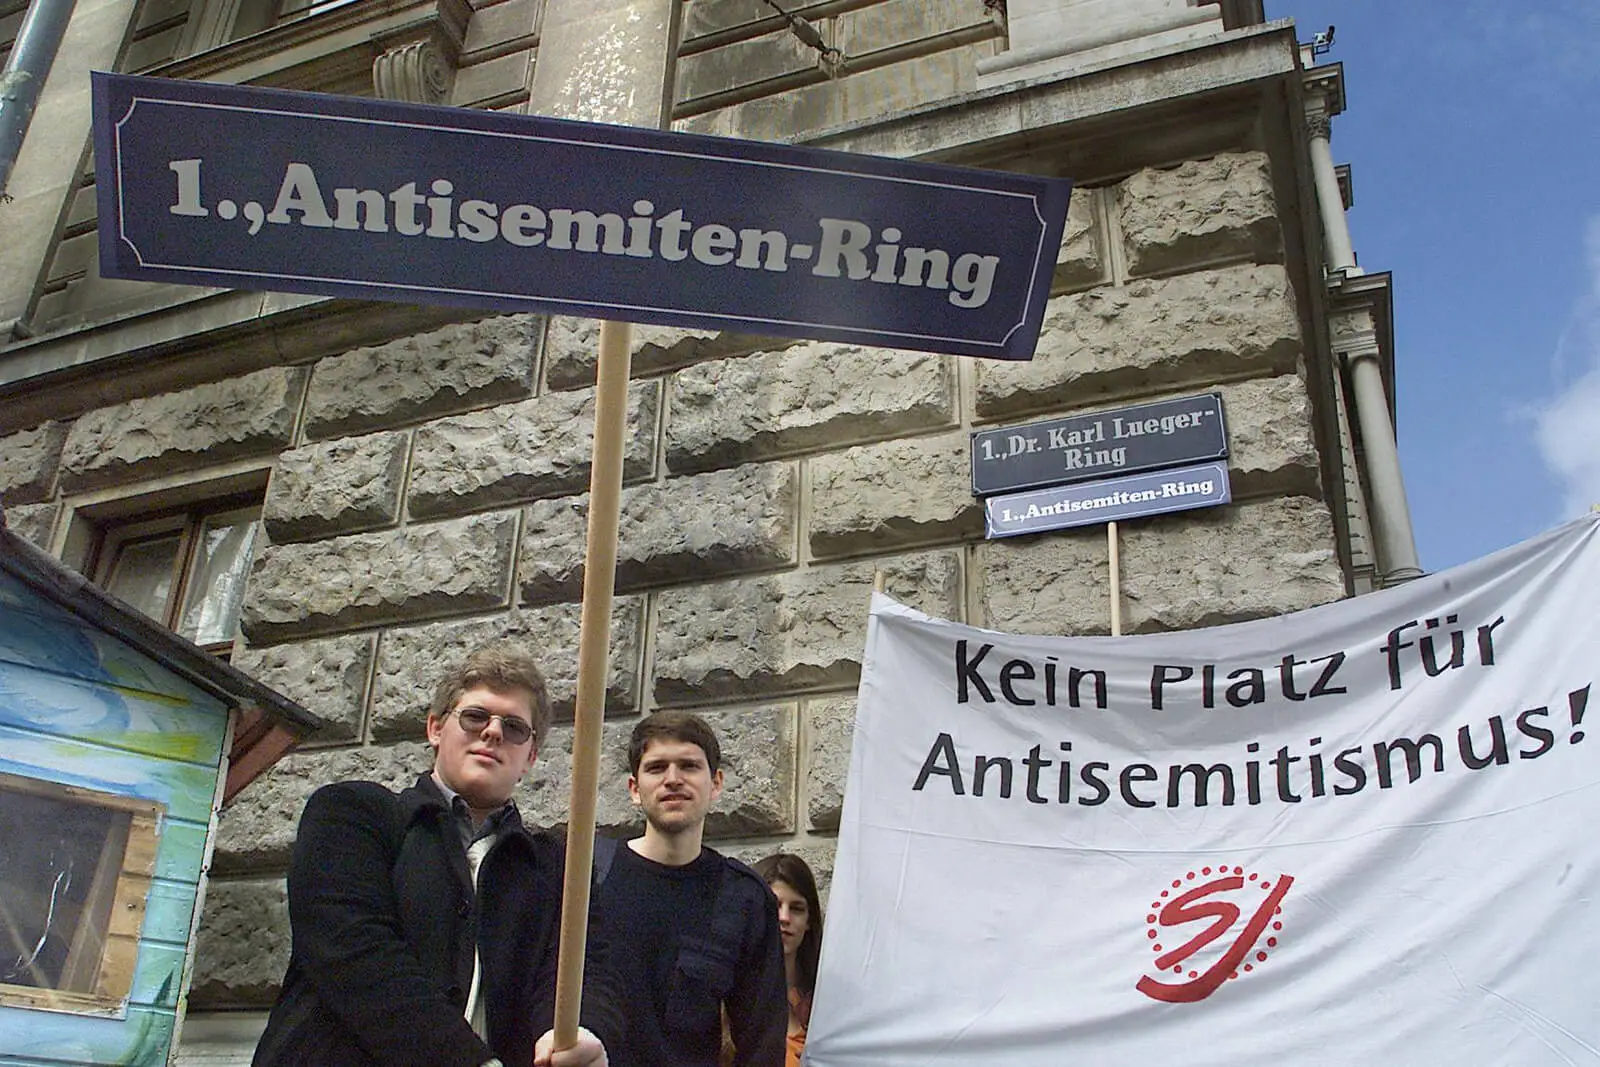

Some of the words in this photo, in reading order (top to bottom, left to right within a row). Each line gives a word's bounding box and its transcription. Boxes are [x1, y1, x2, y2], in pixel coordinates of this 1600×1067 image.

[168, 158, 999, 308] 1.,Antisemiten-Ring
[1048, 421, 1104, 449] Karl
[1112, 409, 1214, 440] Lueger-
[1064, 447, 1126, 471] Ring
[956, 640, 1107, 709] Kein
[1151, 651, 1347, 709] Platz
[1380, 615, 1504, 690] für
[912, 683, 1591, 807] Antisemitismus!
